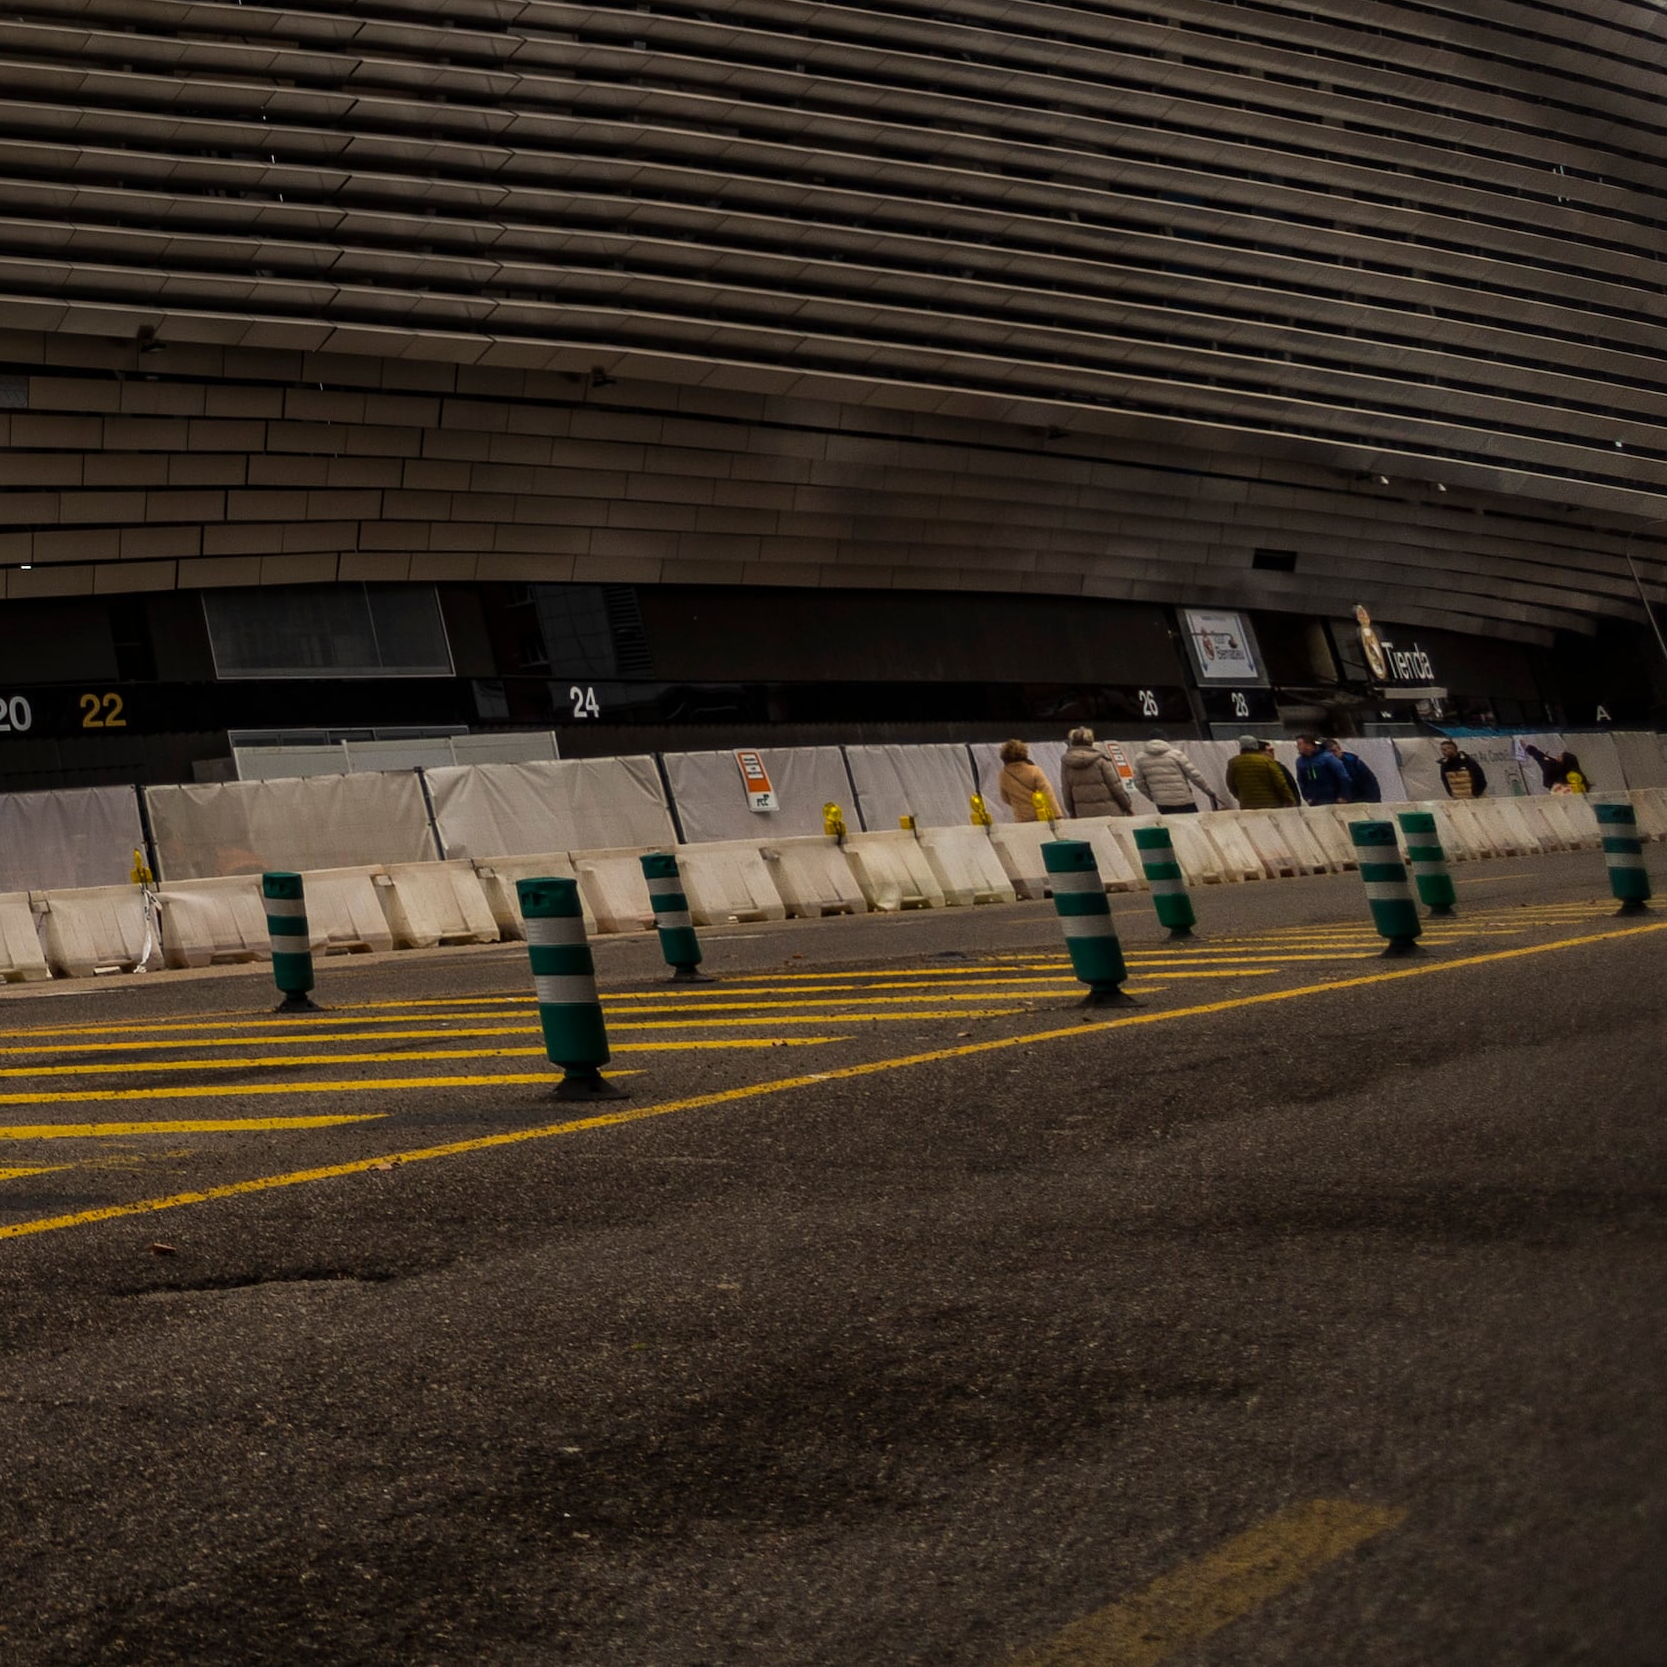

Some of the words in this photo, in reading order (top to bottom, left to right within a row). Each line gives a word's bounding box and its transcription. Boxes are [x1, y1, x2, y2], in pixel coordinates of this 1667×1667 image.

[1380, 641, 1435, 680] Tienda
[79, 691, 127, 729] 22
[569, 685, 600, 718] 24
[1138, 689, 1159, 717] 26
[1230, 692, 1249, 717] 28
[1595, 704, 1612, 722] A
